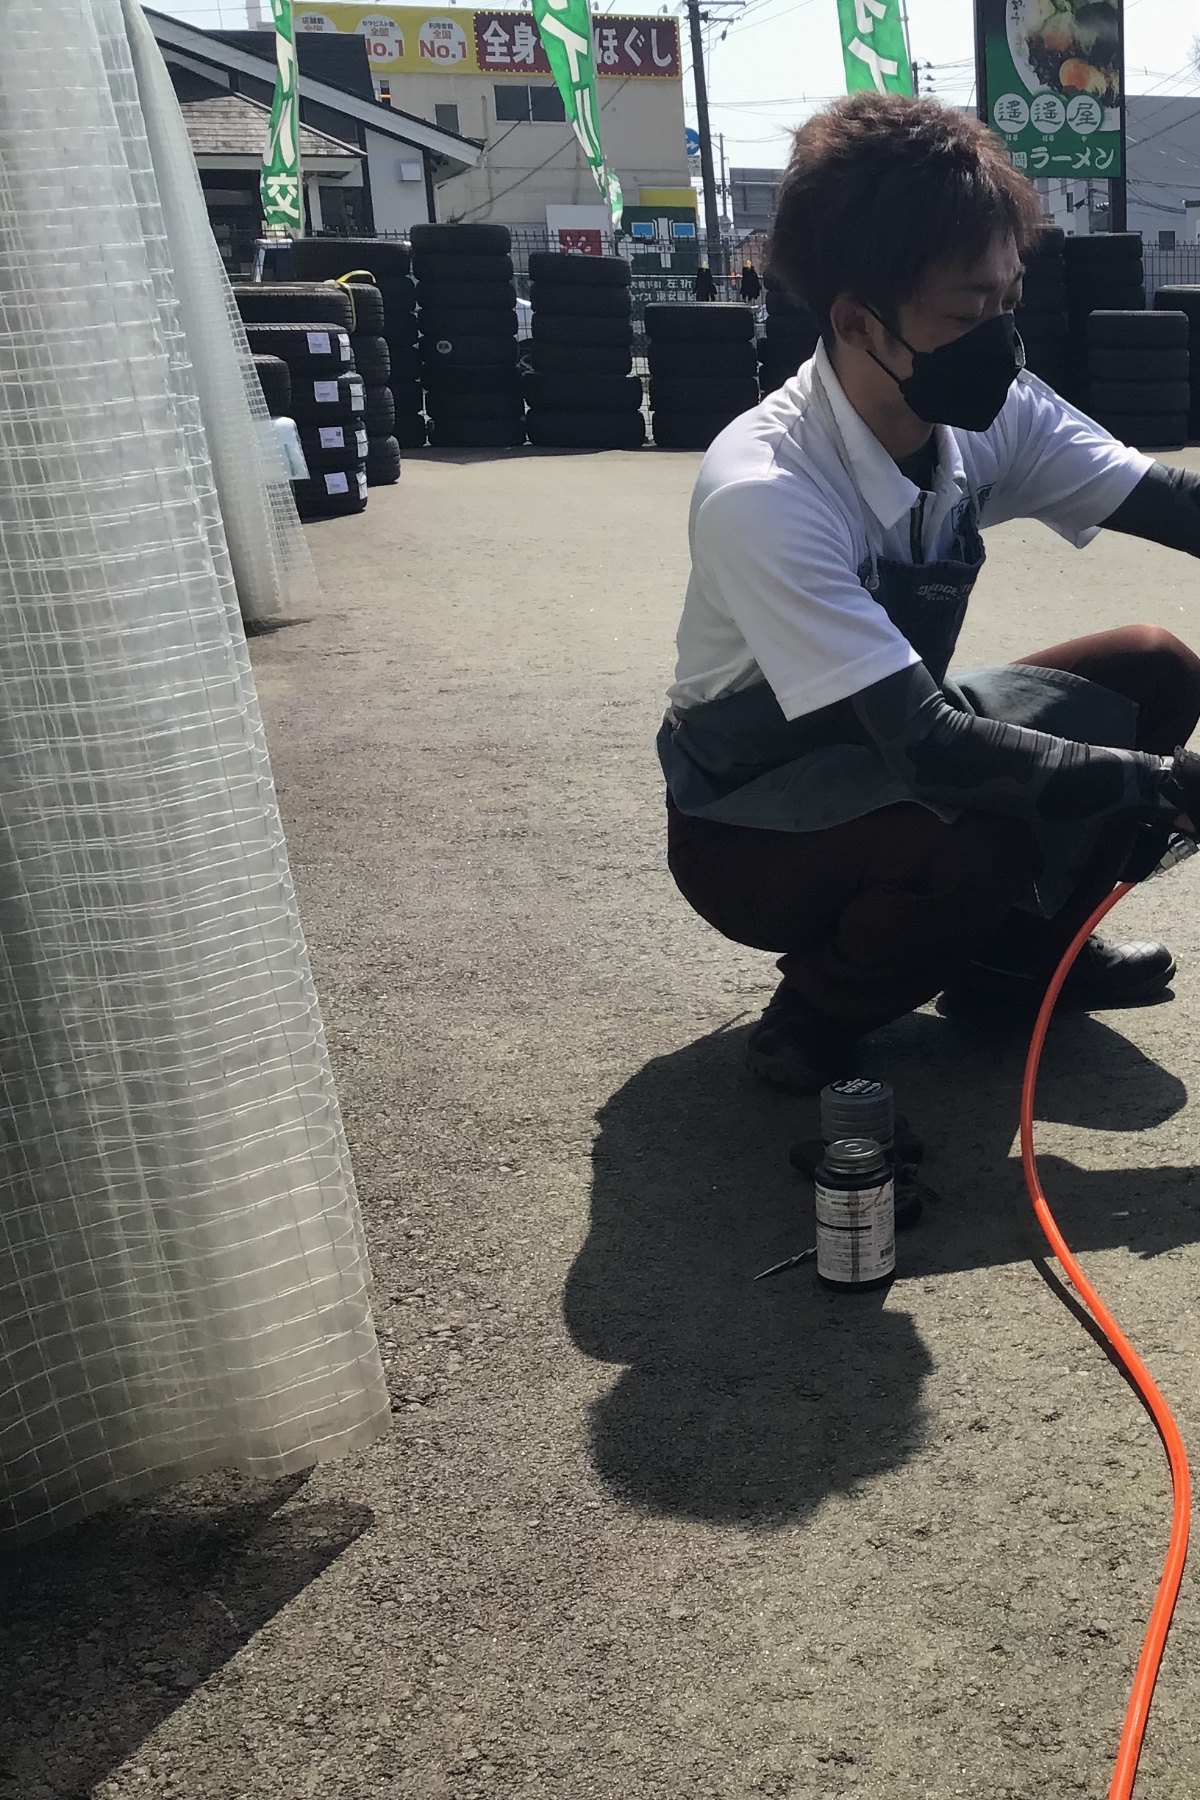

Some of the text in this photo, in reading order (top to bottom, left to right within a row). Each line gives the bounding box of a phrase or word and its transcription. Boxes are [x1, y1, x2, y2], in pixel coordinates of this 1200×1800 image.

[362, 20, 396, 28] セラピスト数
[428, 22, 454, 30] 利用者数
[370, 27, 389, 37] 全国
[432, 30, 452, 40] 全国
[482, 20, 673, 68] 全身ほぐし
[419, 40, 467, 59] No.1
[1010, 146, 1115, 170] 岡ラーメン
